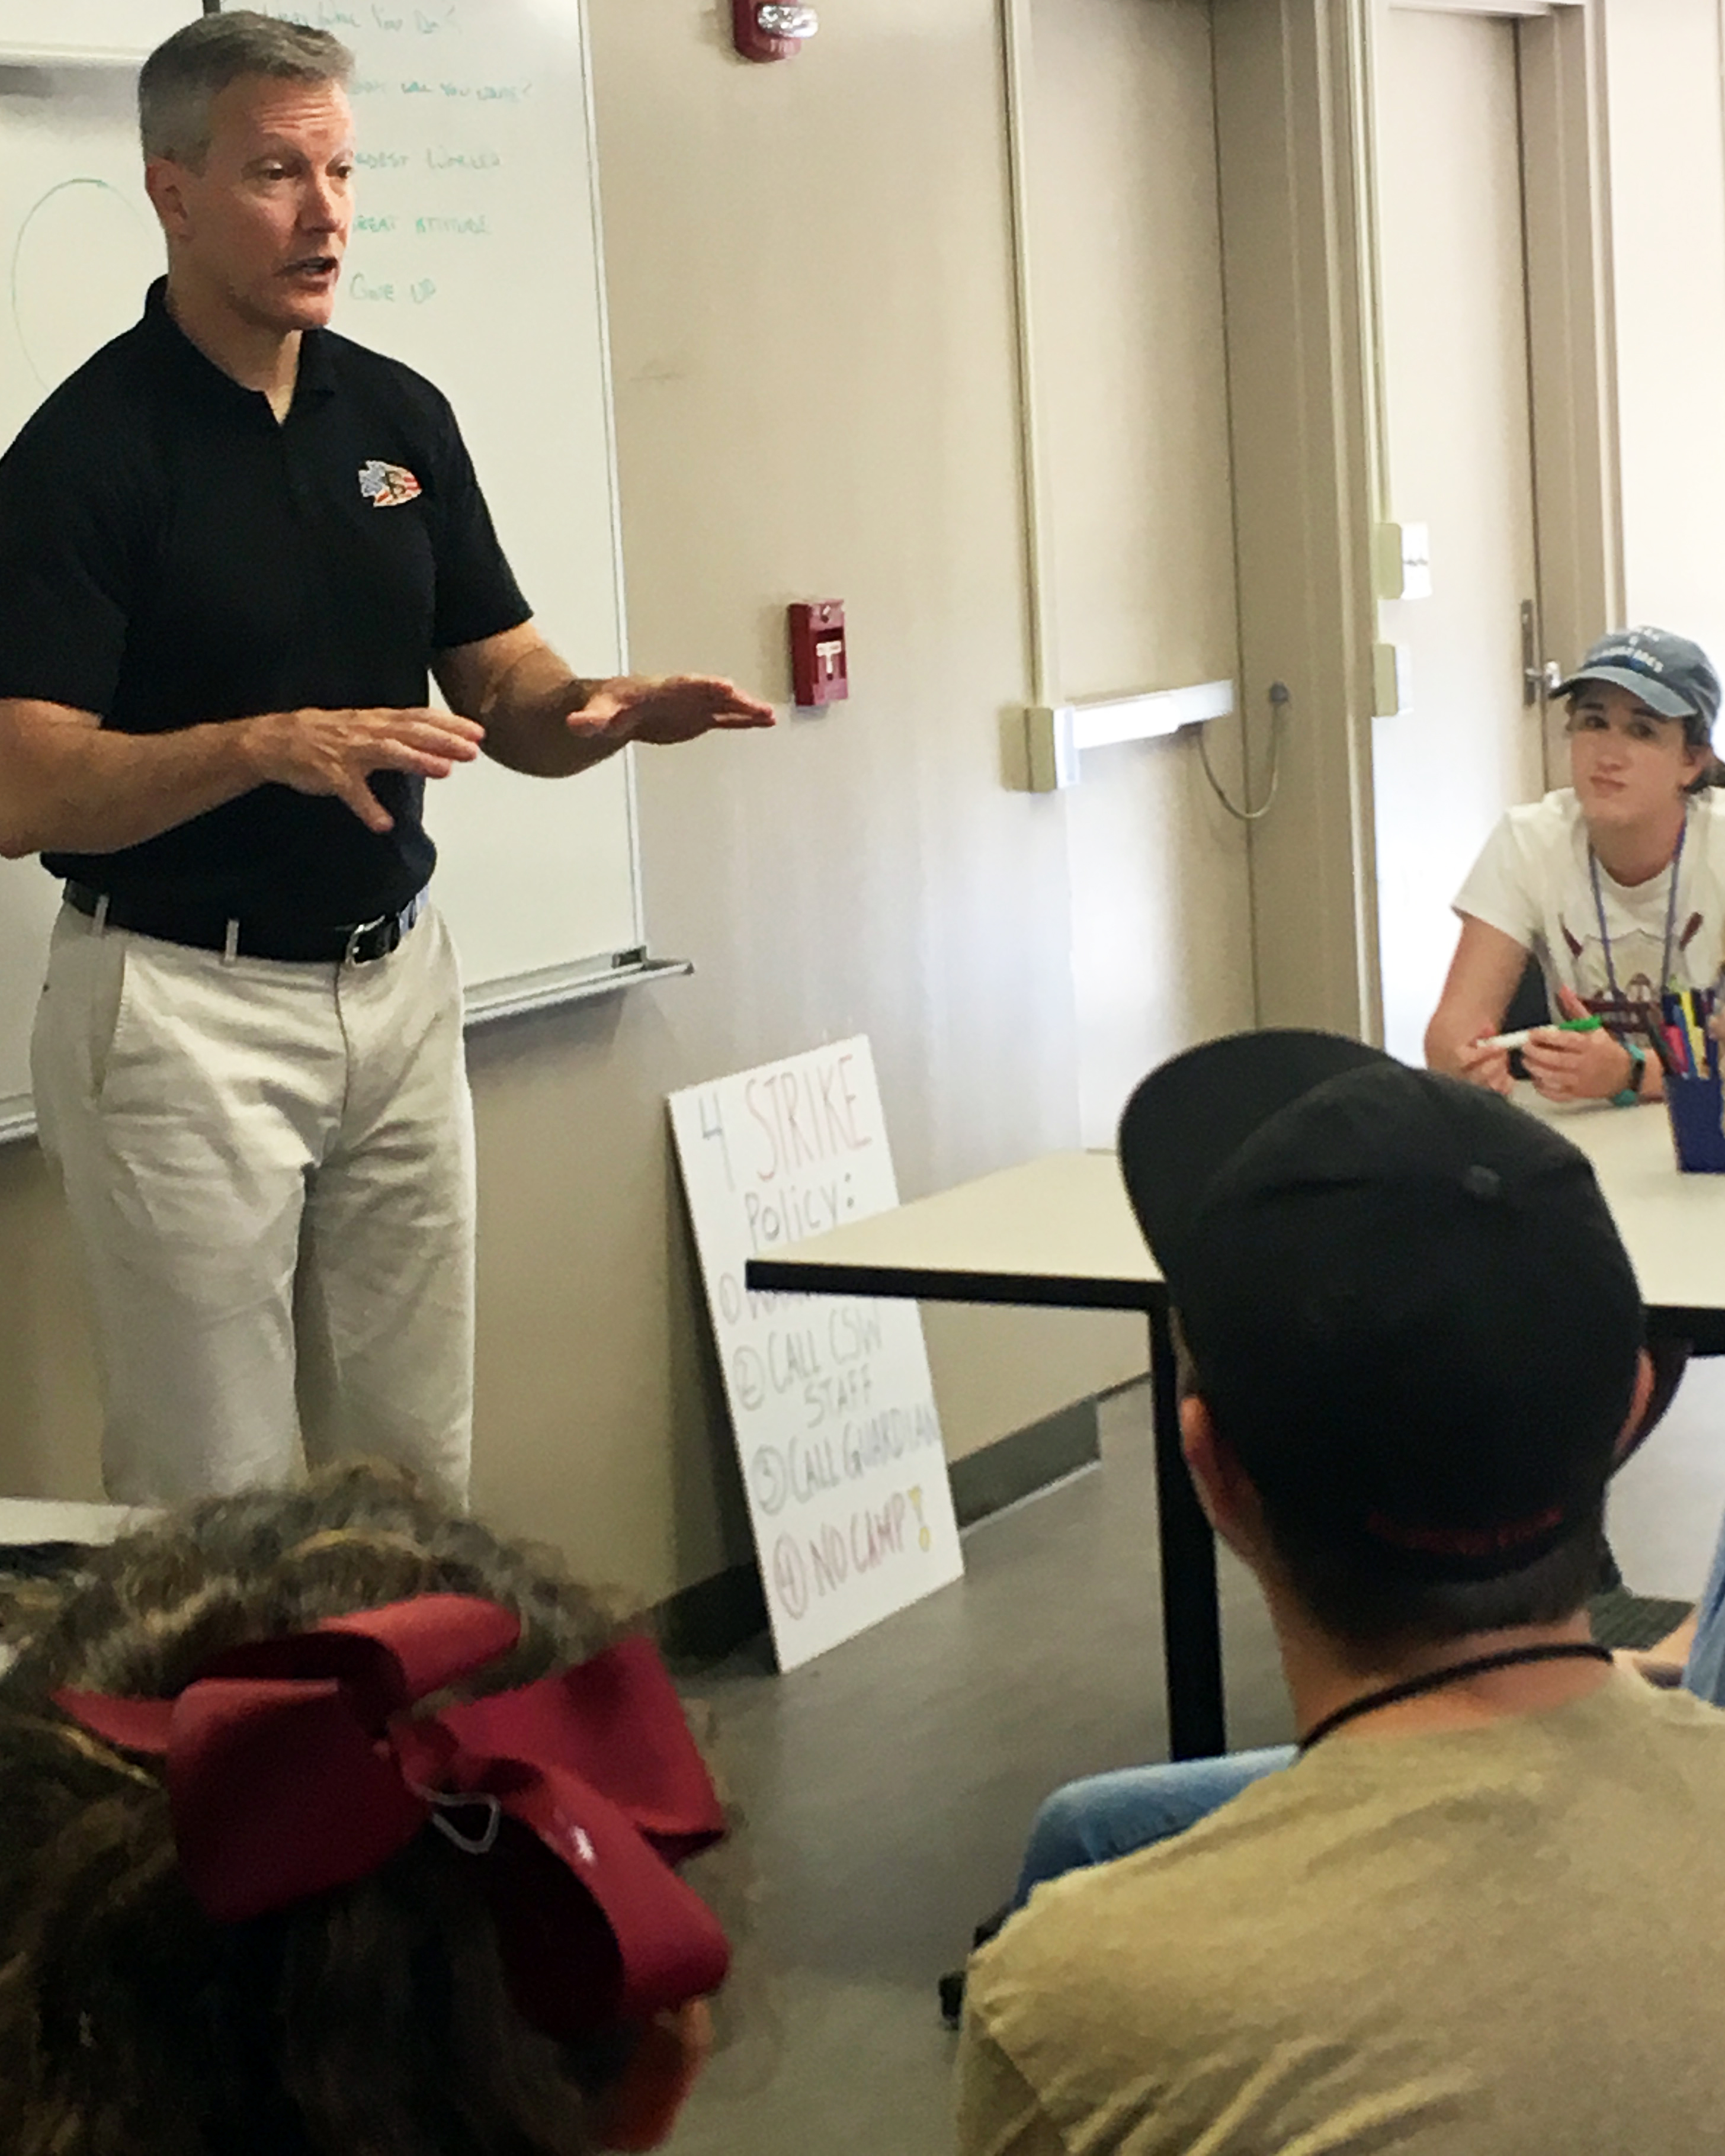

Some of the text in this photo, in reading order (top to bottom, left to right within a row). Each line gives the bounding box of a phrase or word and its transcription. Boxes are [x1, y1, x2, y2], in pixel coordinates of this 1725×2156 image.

[699, 1055, 871, 1192] 4 STRIKE
[768, 1329, 822, 1394] CALL
[804, 1364, 872, 1428] STAFF
[788, 1435, 841, 1504] CALL
[842, 1400, 940, 1480] GUARDIAN
[809, 1522, 848, 1597] NO
